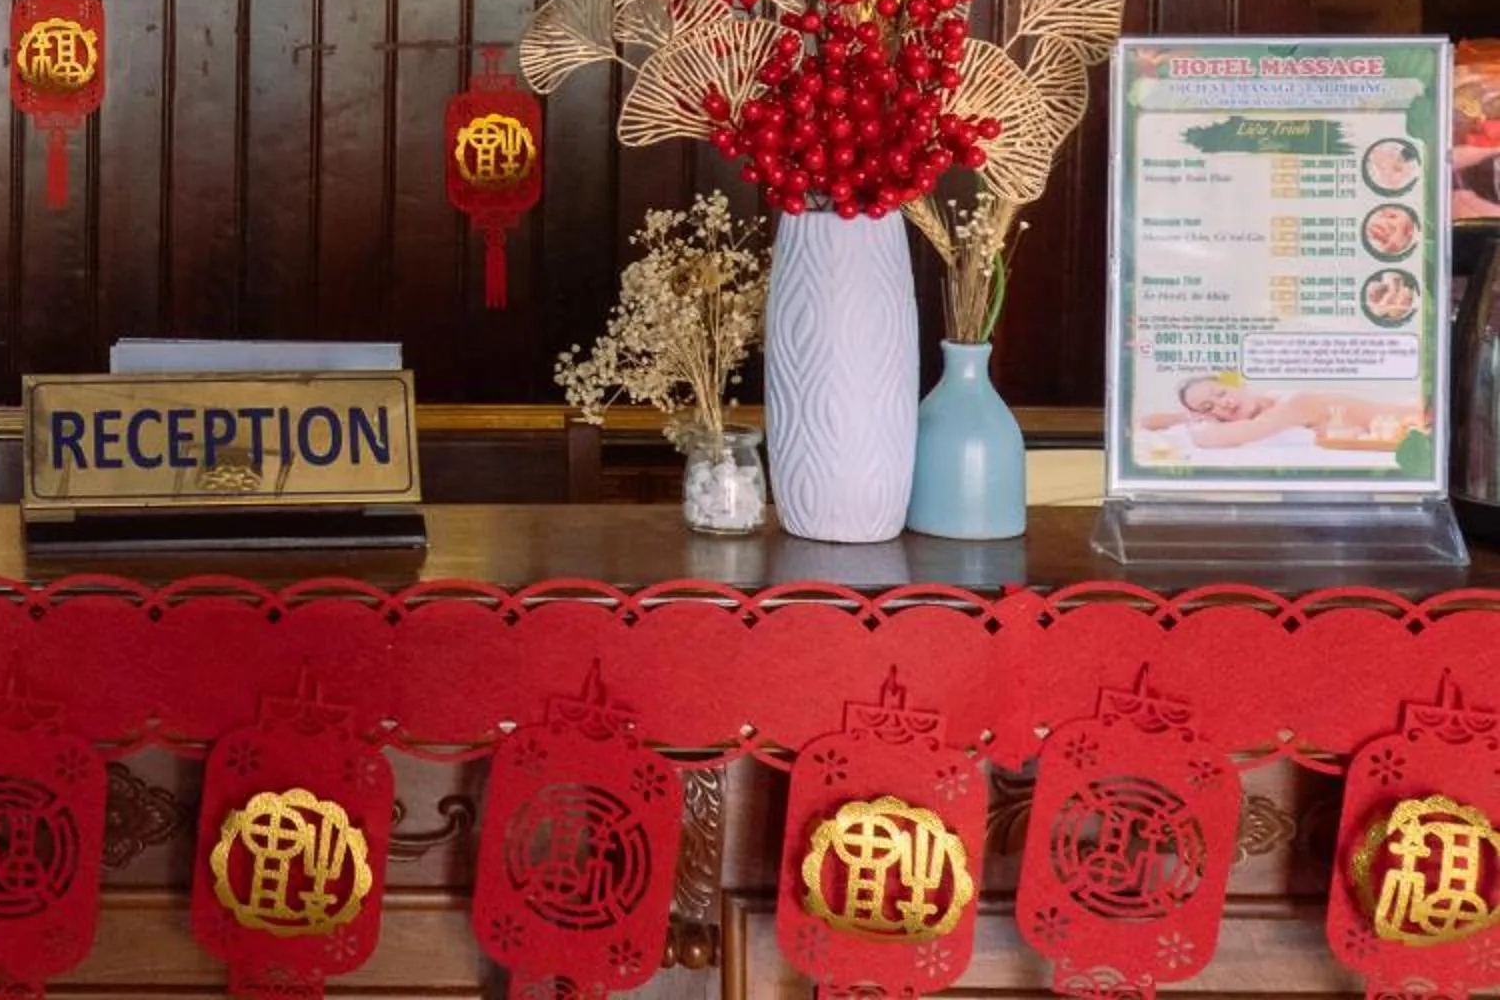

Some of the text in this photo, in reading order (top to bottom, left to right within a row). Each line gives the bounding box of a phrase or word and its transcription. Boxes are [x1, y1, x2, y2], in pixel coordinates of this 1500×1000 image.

[1171, 57, 1385, 77] HOTEL MASSAGE
[51, 406, 390, 471] RECEPTION
